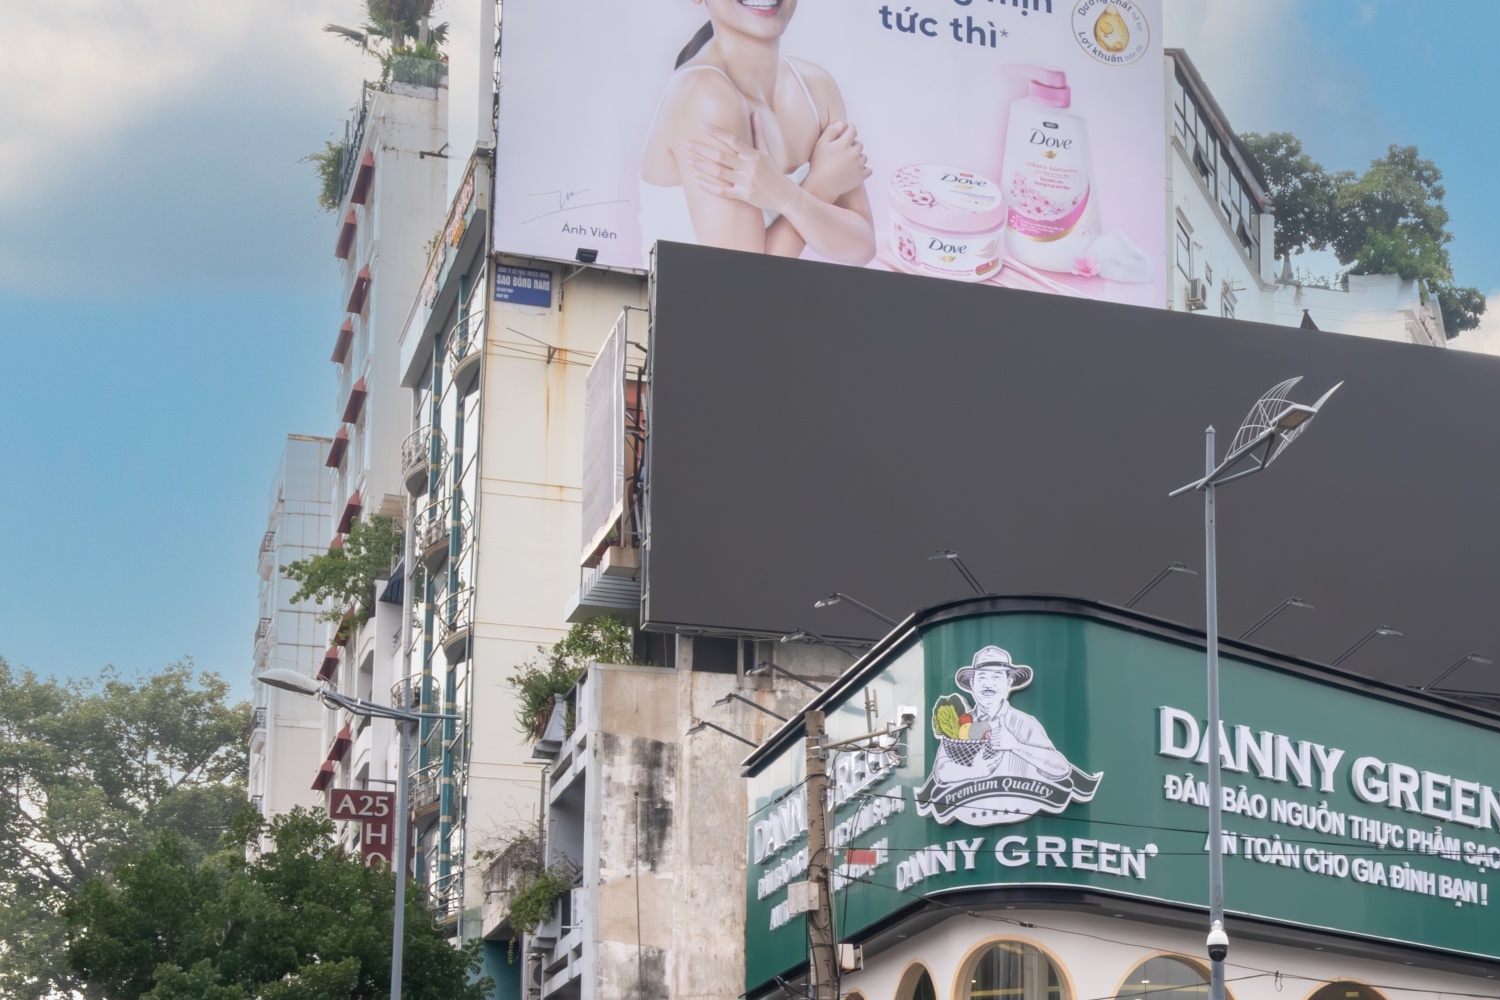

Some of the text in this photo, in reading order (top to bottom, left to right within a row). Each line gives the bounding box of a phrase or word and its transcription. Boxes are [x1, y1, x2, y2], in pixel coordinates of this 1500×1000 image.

[879, 5, 938, 37] tức
[1092, 47, 1123, 63] khuẩn
[1030, 128, 1072, 149] Dove
[941, 173, 987, 187] Dove
[561, 221, 617, 240] Ánh Viên
[928, 237, 967, 254] Dove
[1158, 705, 1346, 793] DANNY
[944, 776, 1053, 805] Premium Quality
[335, 793, 389, 817] A25
[1220, 785, 1268, 819] BẢO
[1271, 800, 1345, 836] NGUỒN
[1348, 815, 1404, 850] THỰC
[1407, 825, 1461, 862] PHẨM
[896, 837, 984, 891] DANNY
[1241, 834, 1300, 869] TOÀN
[1303, 847, 1349, 878] CHO
[1352, 860, 1388, 887] GIA
[1389, 861, 1436, 896] ĐÌNH
[1438, 874, 1478, 907] BẠN
[1480, 883, 1488, 906] !
